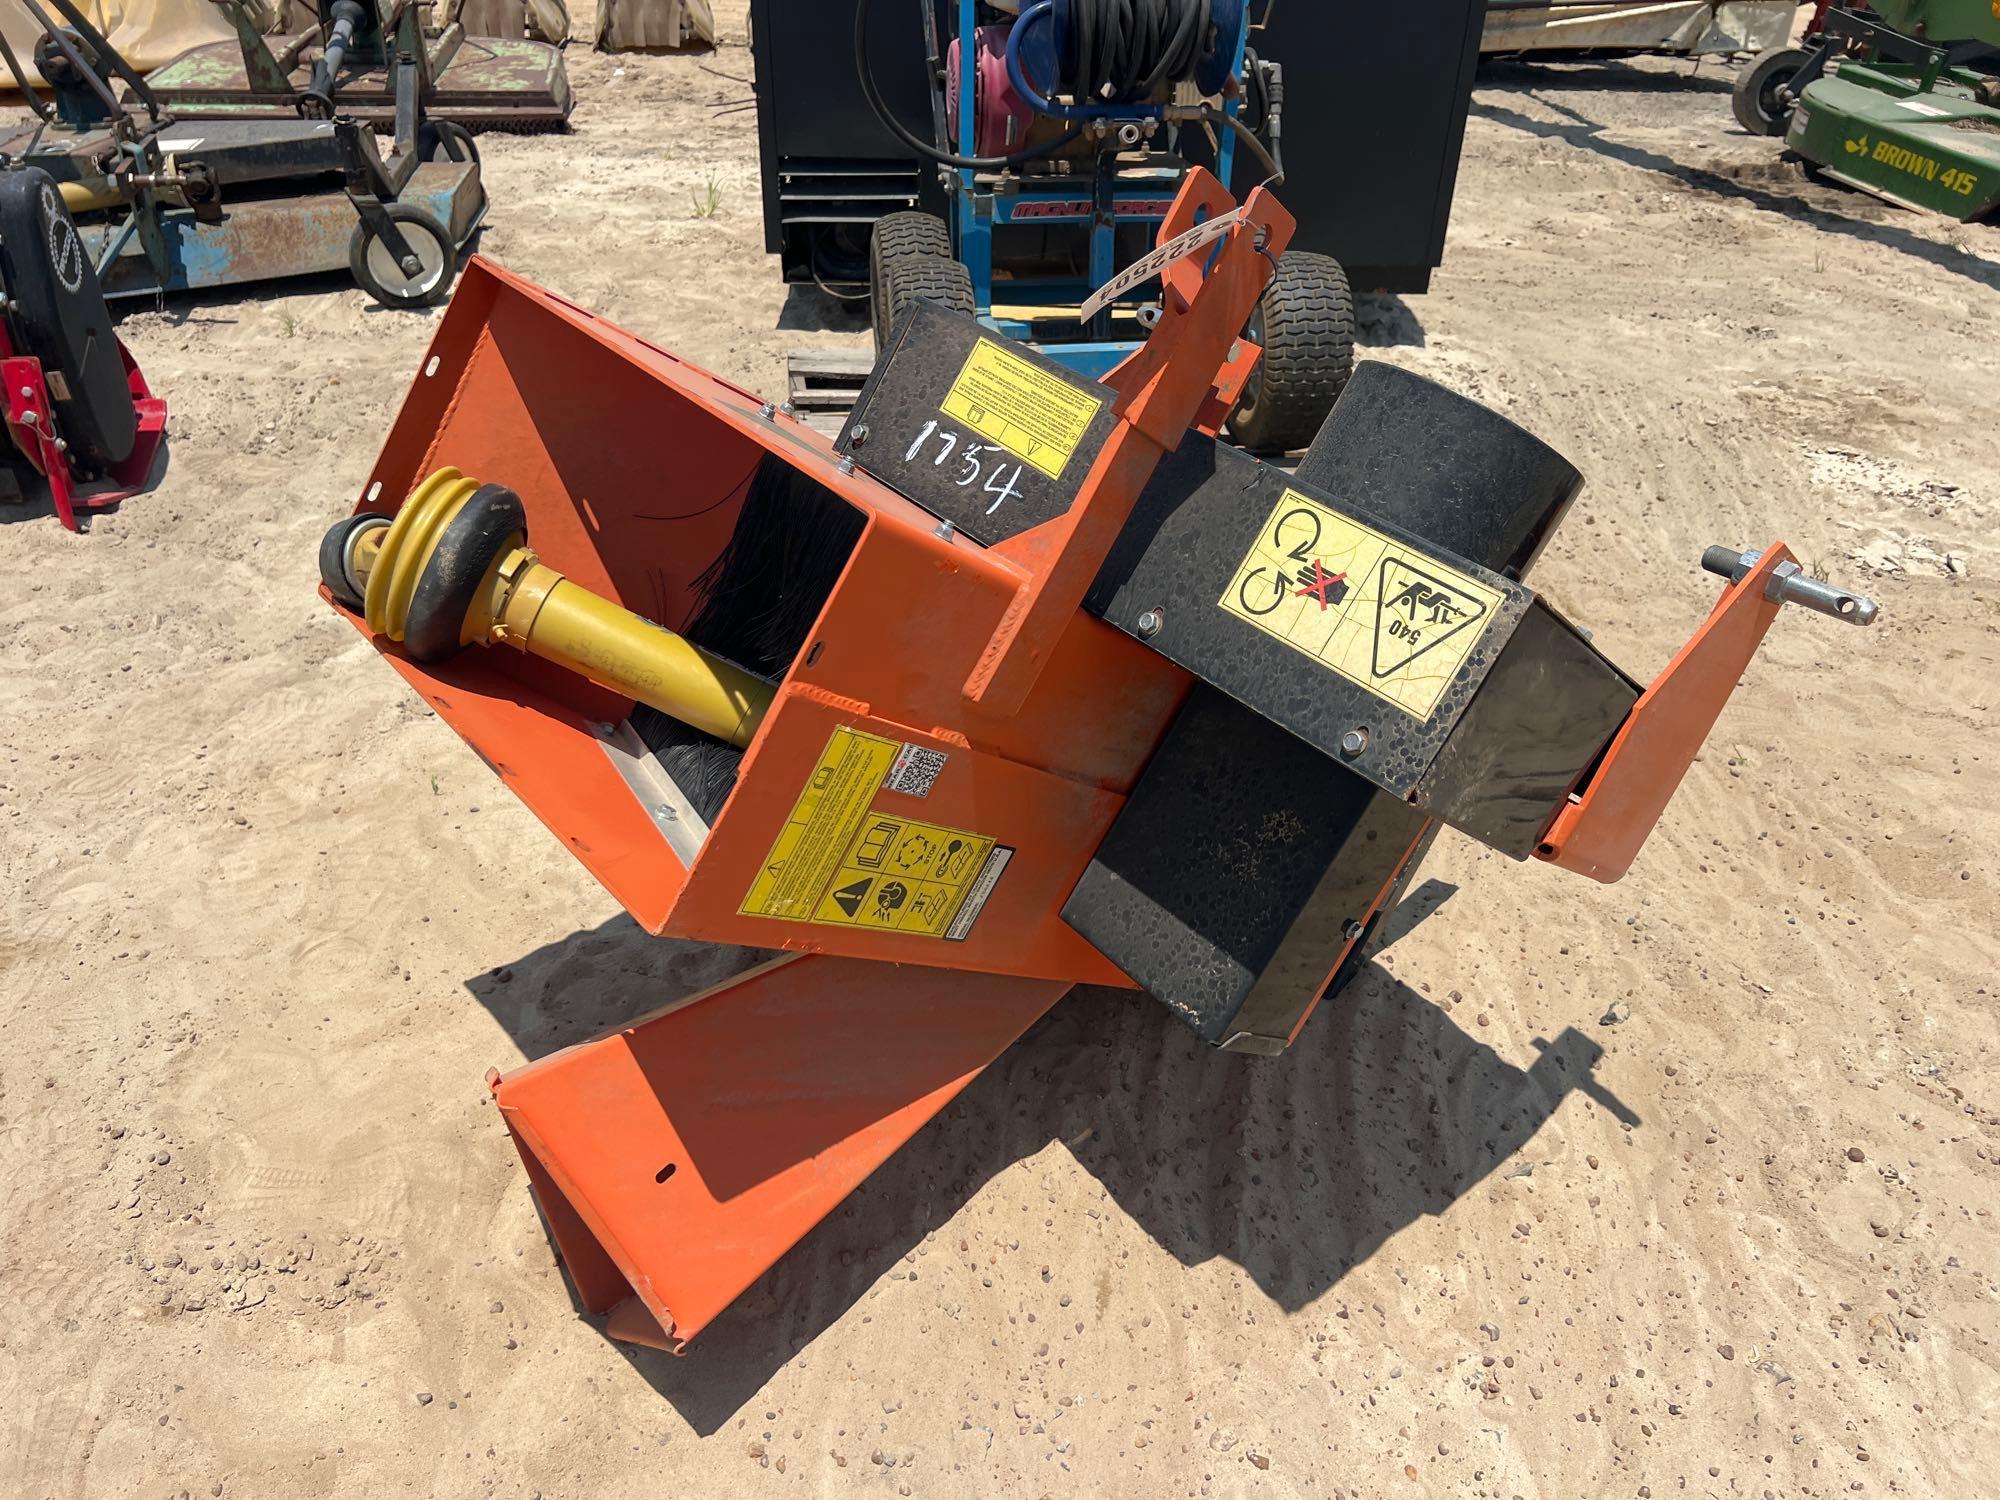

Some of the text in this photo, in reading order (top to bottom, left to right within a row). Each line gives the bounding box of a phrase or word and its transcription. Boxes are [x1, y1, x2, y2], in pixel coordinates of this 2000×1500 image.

[1872, 140, 1978, 195] BROWN 415
[1099, 231, 1203, 303] 222504
[905, 420, 1024, 515] 1754
[1388, 620, 1421, 646] 540
[923, 843, 937, 864] STOP
